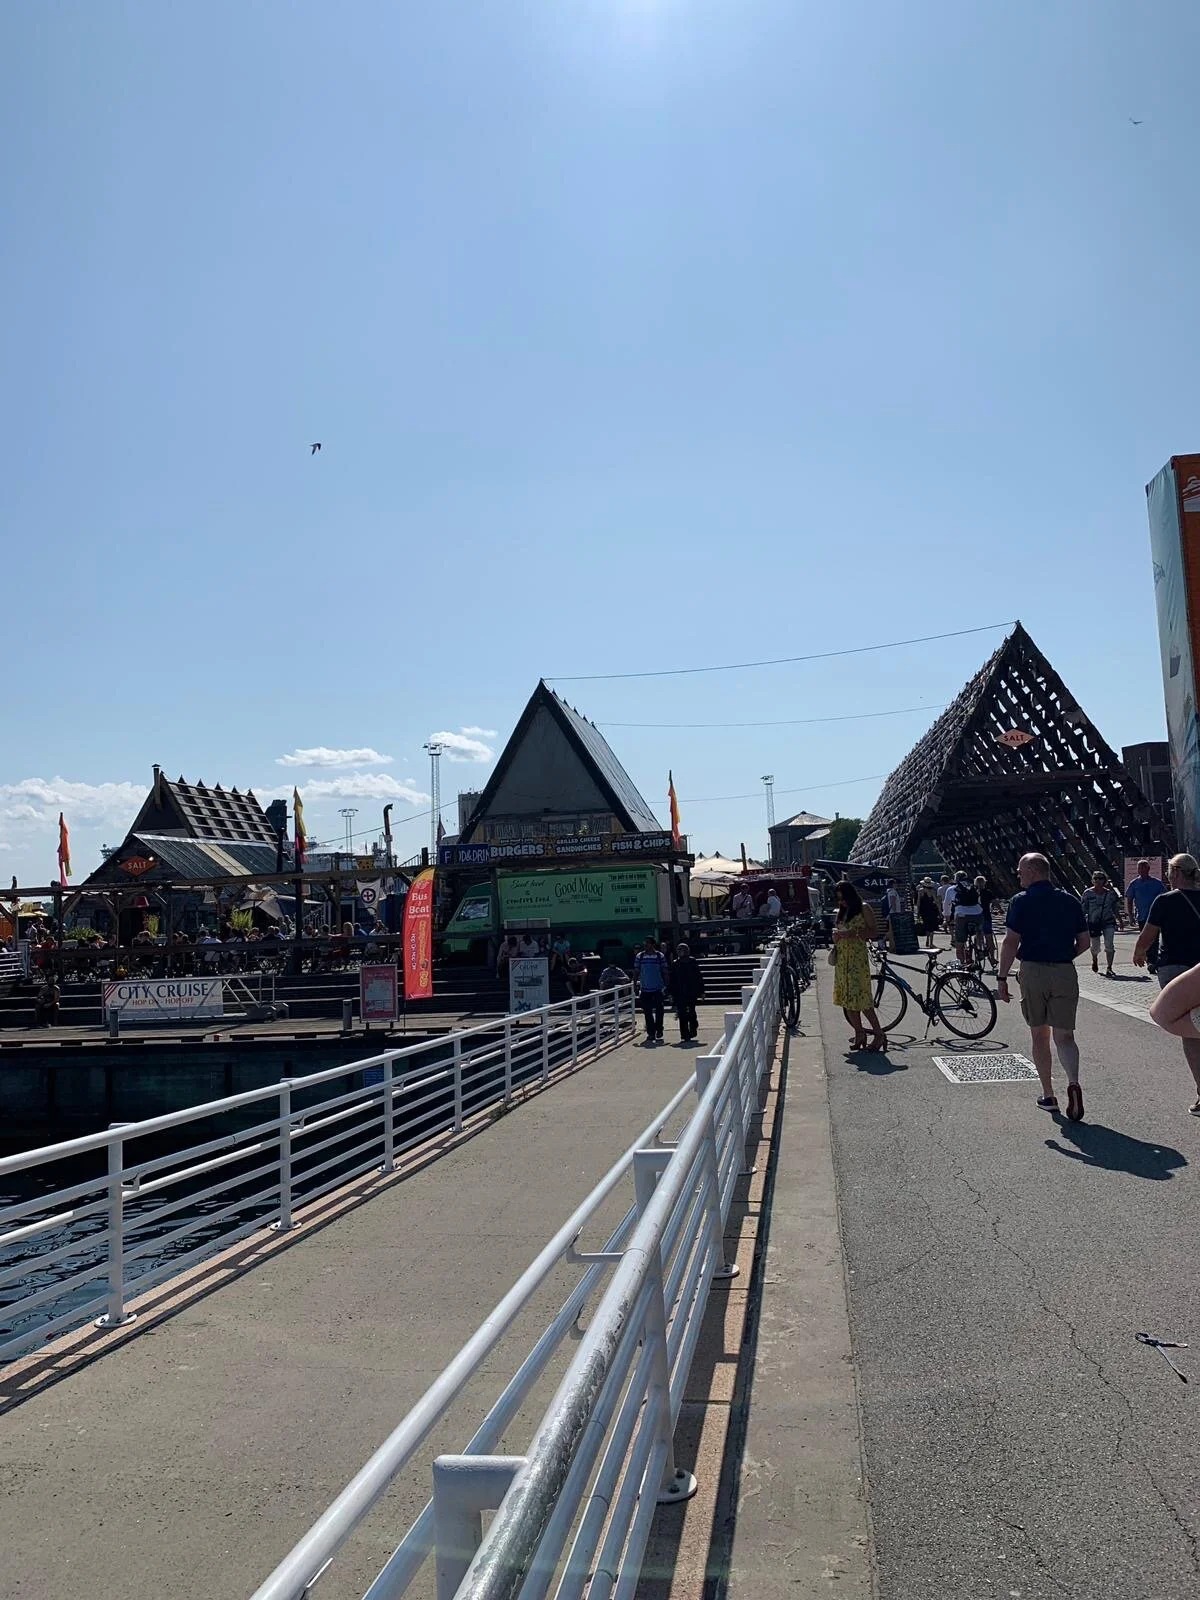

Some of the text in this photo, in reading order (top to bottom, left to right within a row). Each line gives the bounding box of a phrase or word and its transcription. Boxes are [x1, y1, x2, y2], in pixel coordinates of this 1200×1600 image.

[556, 843, 602, 853] SANDWICHES
[612, 838, 671, 851] FISH & CHIPS
[489, 844, 544, 857] BURGERS
[554, 877, 604, 898] Good Mood
[864, 878, 889, 887] SALT
[411, 892, 428, 901] Bus
[408, 905, 430, 914] Boat
[117, 983, 209, 1000] CITY CRUISE
